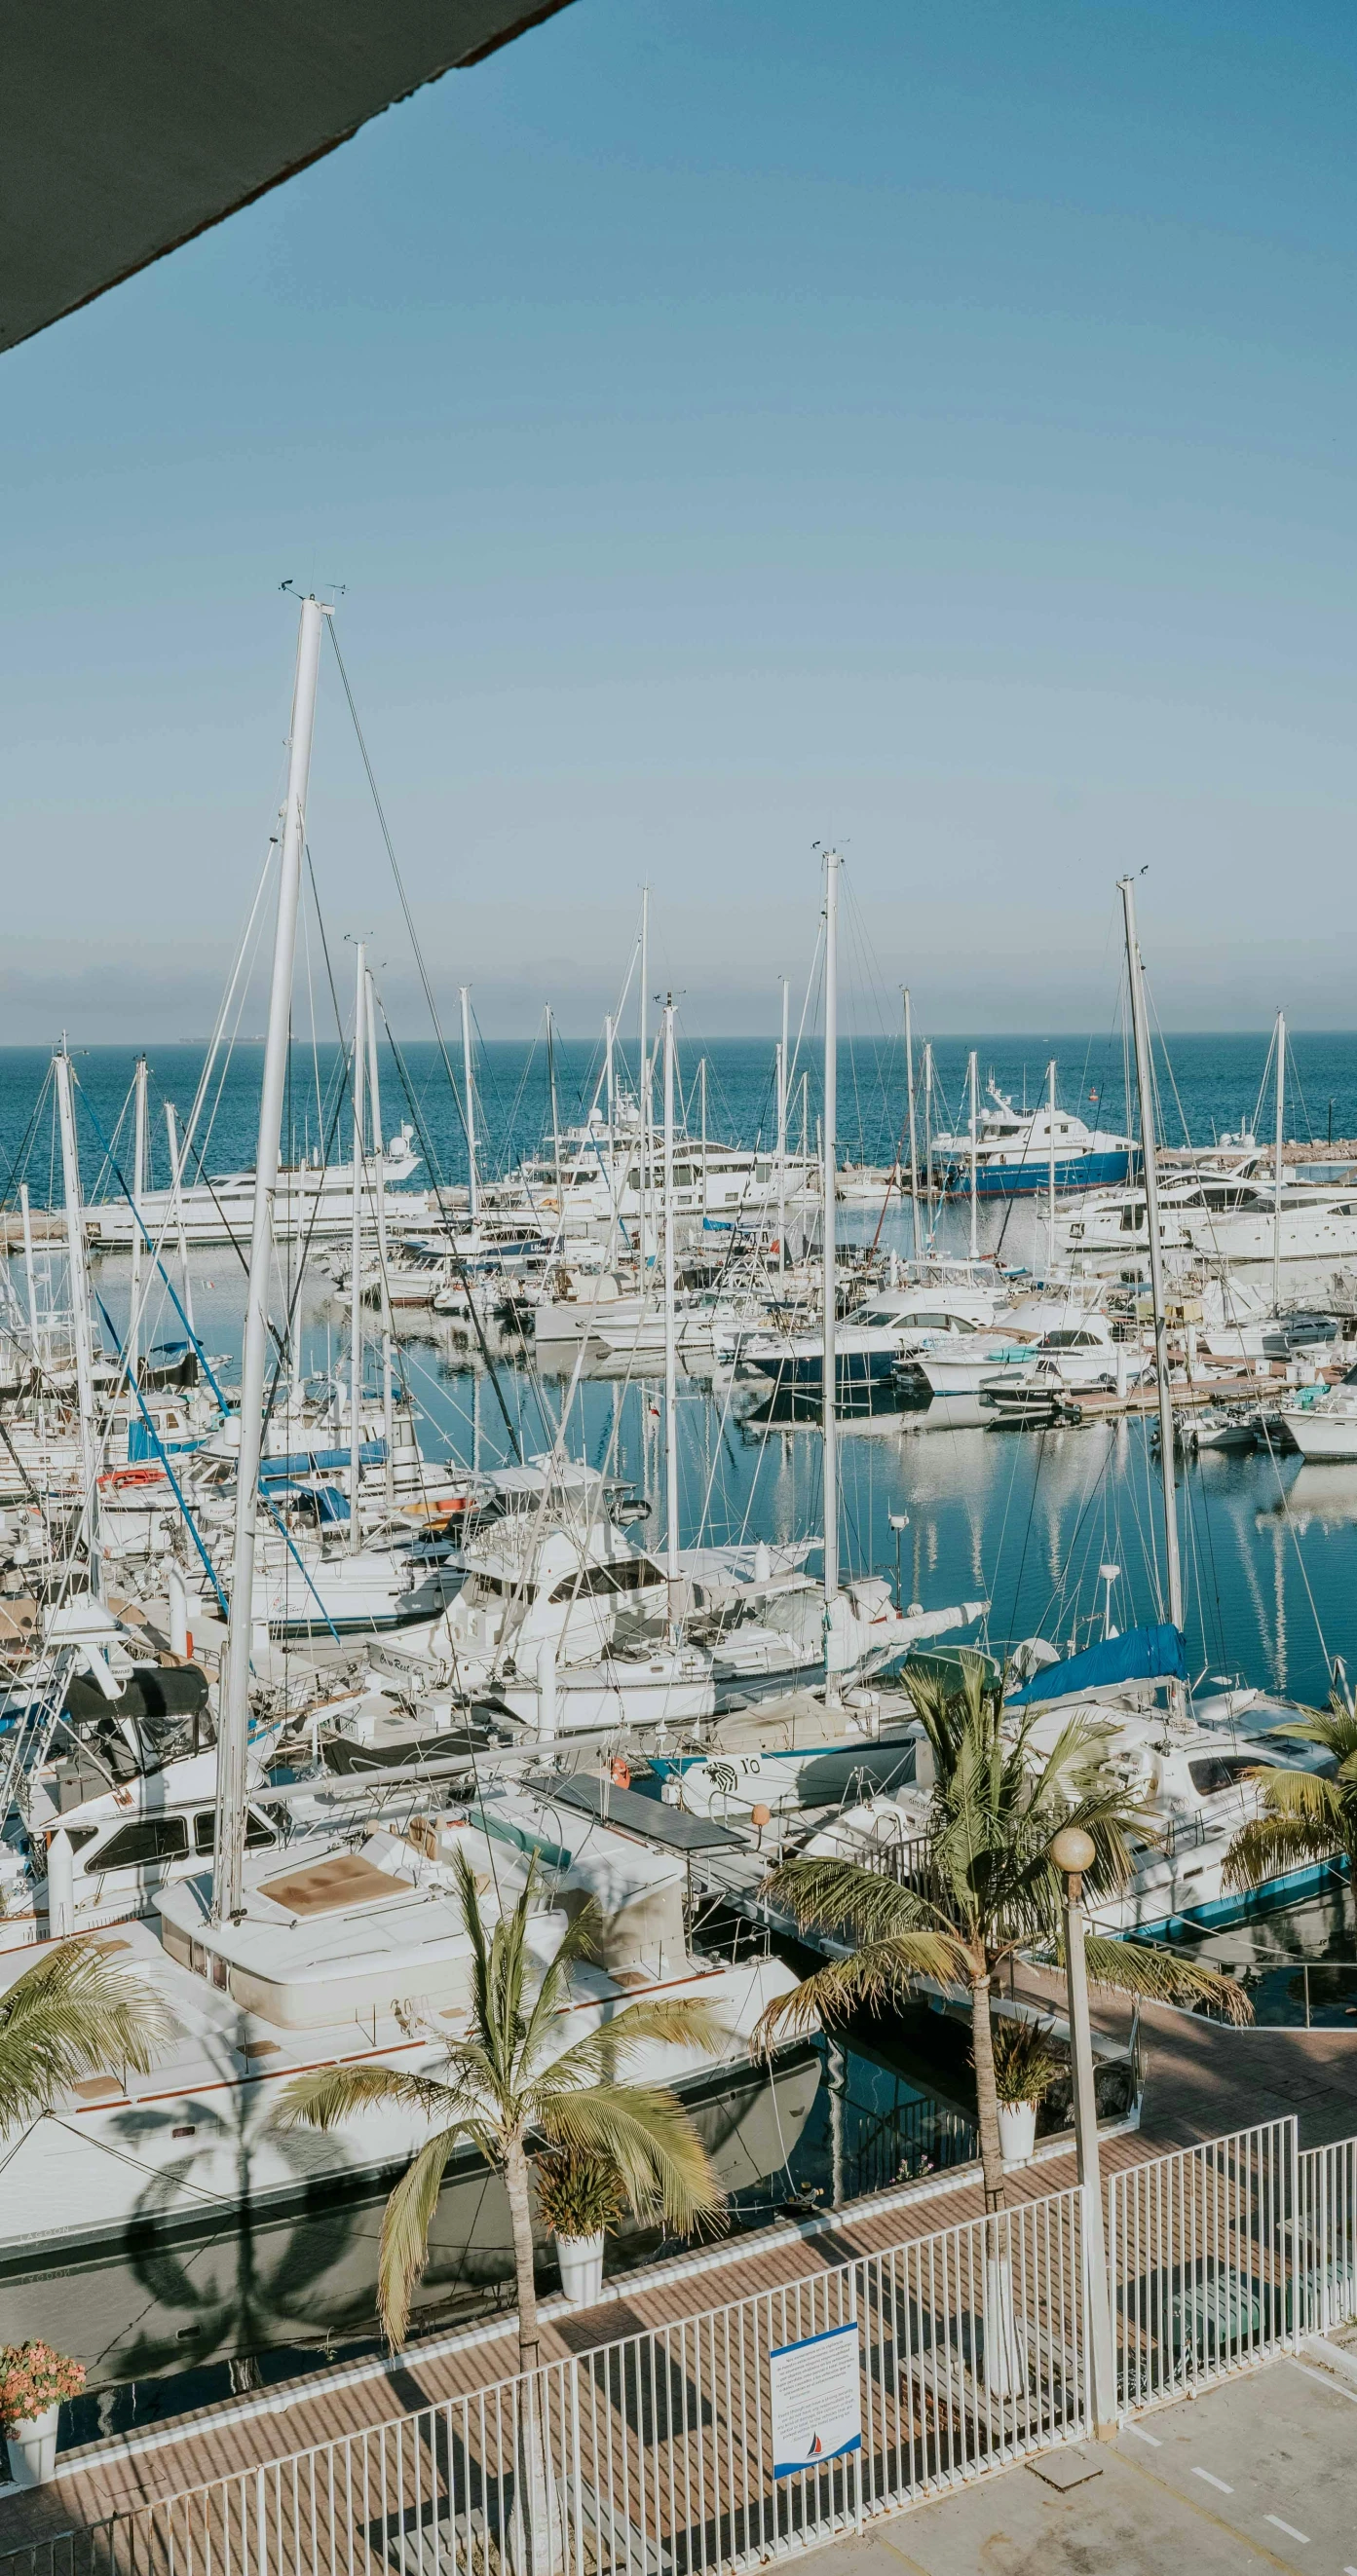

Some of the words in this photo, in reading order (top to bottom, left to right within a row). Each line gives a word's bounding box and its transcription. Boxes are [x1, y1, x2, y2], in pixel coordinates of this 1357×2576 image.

[531, 1243, 560, 1251] Libertd
[394, 1659, 410, 1672] Rest
[909, 1798, 921, 1808] GATO
[19, 2225, 69, 2240] LAGOON
